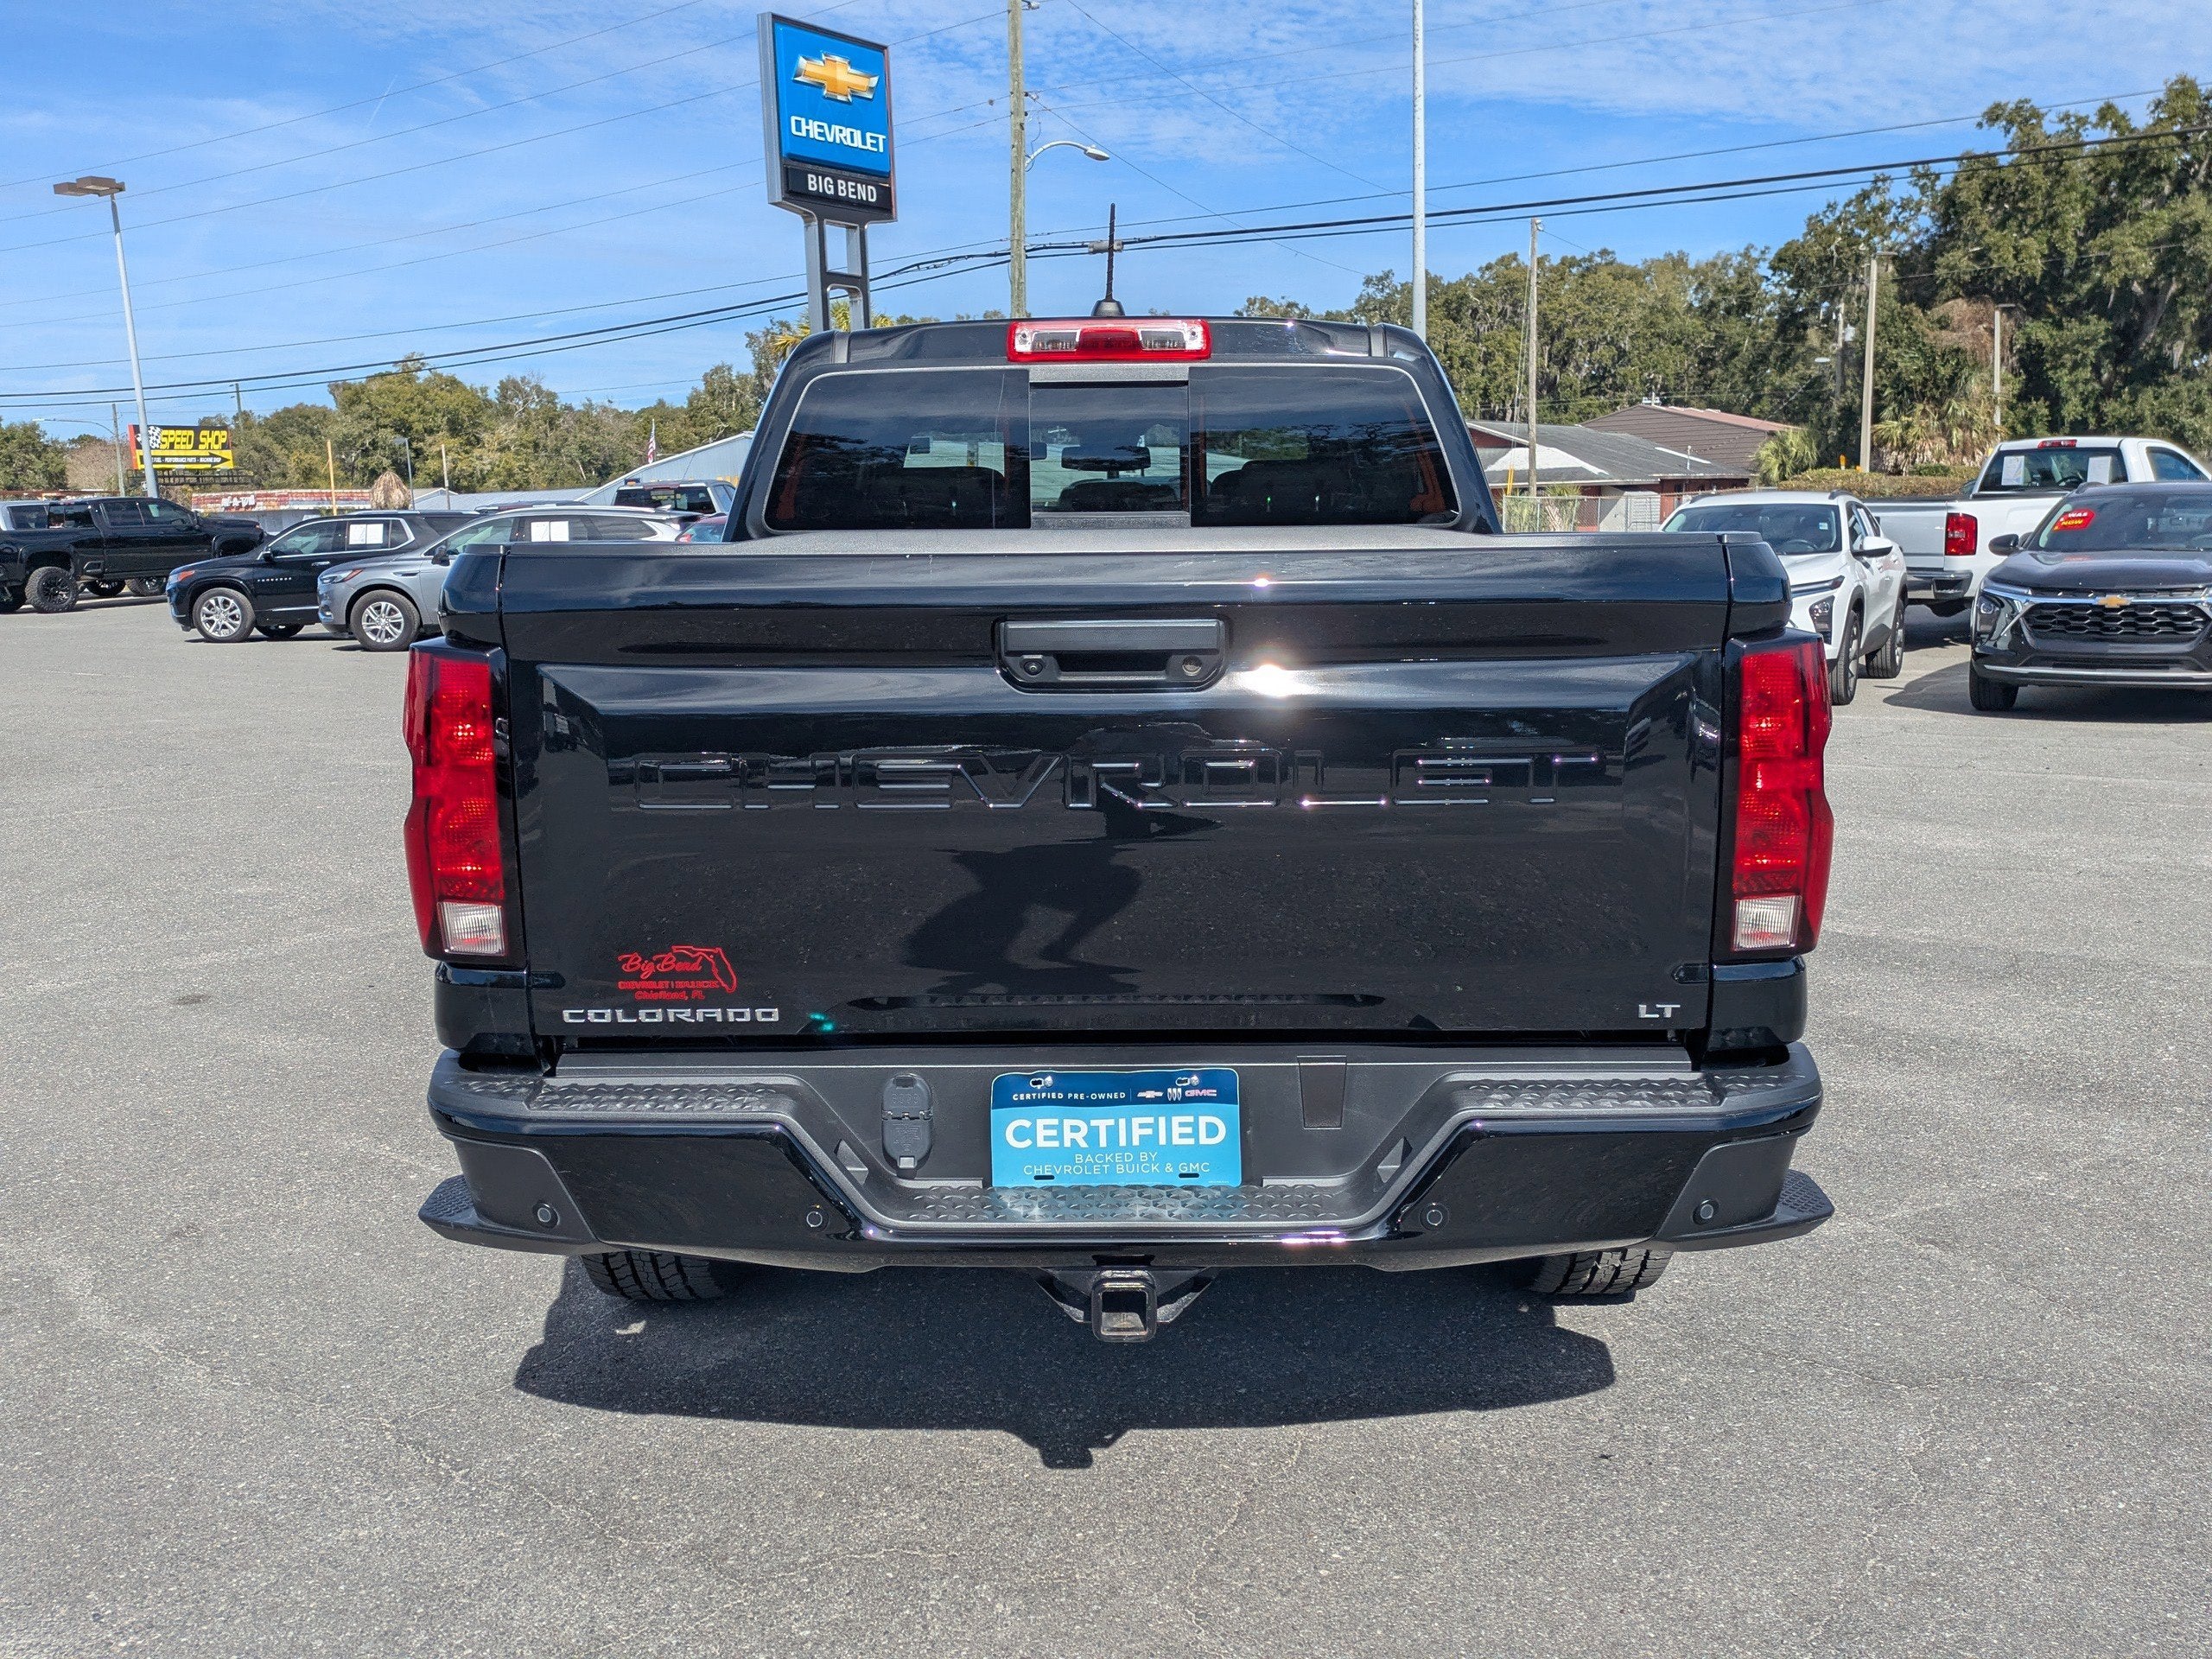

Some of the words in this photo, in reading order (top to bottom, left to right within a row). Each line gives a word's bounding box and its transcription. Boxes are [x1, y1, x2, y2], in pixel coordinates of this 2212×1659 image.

[790, 115, 887, 153] CHEVROLET
[807, 174, 835, 195] BIG
[837, 180, 877, 203] BEND
[159, 429, 194, 450] SPEED
[198, 429, 227, 450] SHOP
[636, 748, 1605, 809] CHEVROLET
[617, 952, 655, 979] Big
[652, 952, 702, 972] Bend
[562, 1007, 779, 1023] COLORADO
[1637, 1004, 1681, 1018] LT
[1012, 1092, 1064, 1101] CERTIFIED
[1067, 1091, 1126, 1100] PRE-OWNED
[1005, 1116, 1227, 1149] CERTIFIED
[1023, 1164, 1110, 1175] CHEVROLET
[1116, 1163, 1160, 1174] BUICK
[1165, 1163, 1173, 1173] &
[1179, 1162, 1210, 1173] GMC
[1075, 1152, 1134, 1164] BACKED
[1140, 1152, 1159, 1162] BY
